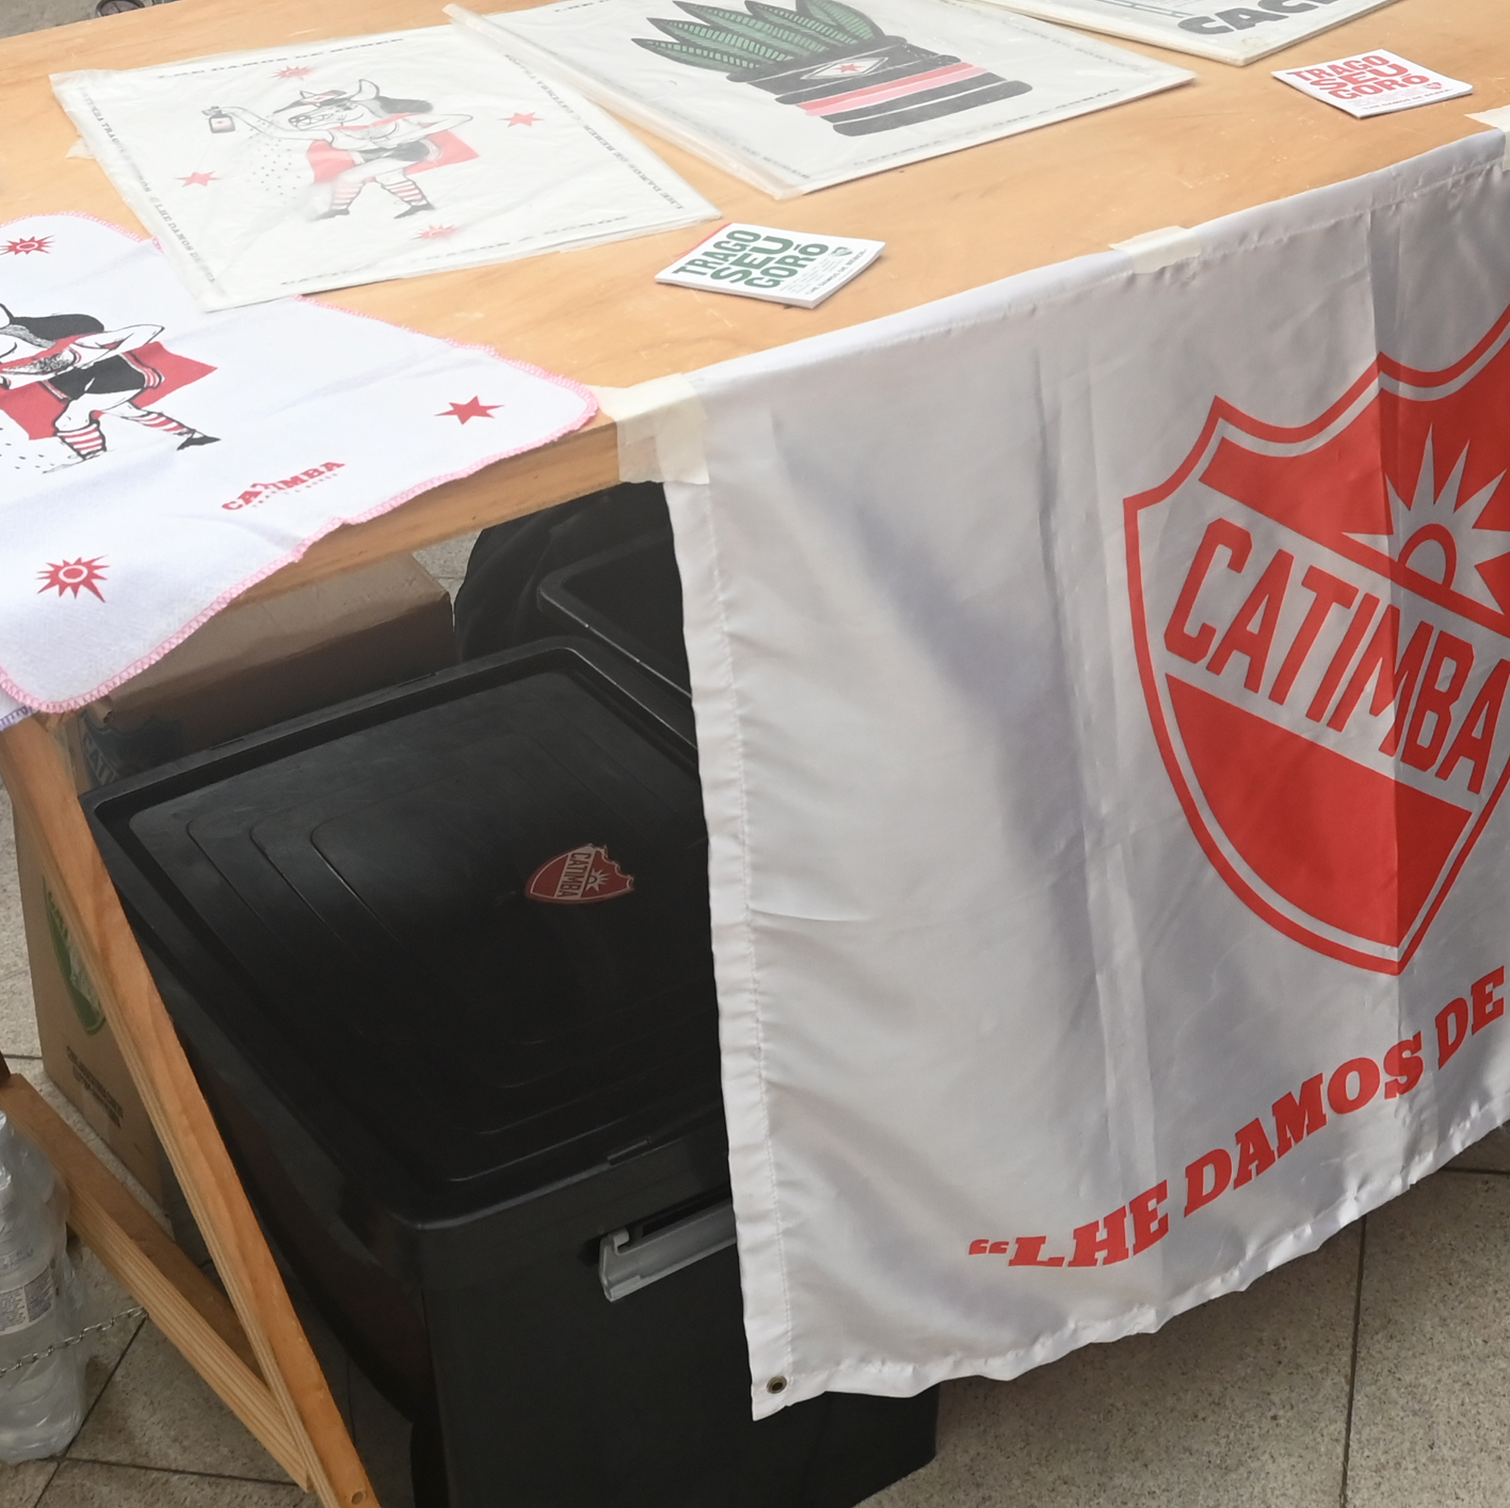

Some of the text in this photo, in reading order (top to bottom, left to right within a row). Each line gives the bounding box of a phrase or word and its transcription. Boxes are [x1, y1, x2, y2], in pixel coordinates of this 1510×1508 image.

[1287, 54, 1391, 82] TRAGO
[1309, 63, 1410, 92] SEU
[1328, 71, 1431, 100] GORÓ
[672, 229, 762, 277] TRAGO
[709, 235, 795, 284] SEU
[743, 242, 830, 289] GORÓ
[556, 852, 592, 898] CATIMBA
[967, 1179, 1170, 1269] “LHE
[1184, 1033, 1424, 1218] DAMOS
[1436, 964, 1506, 1069] DE
